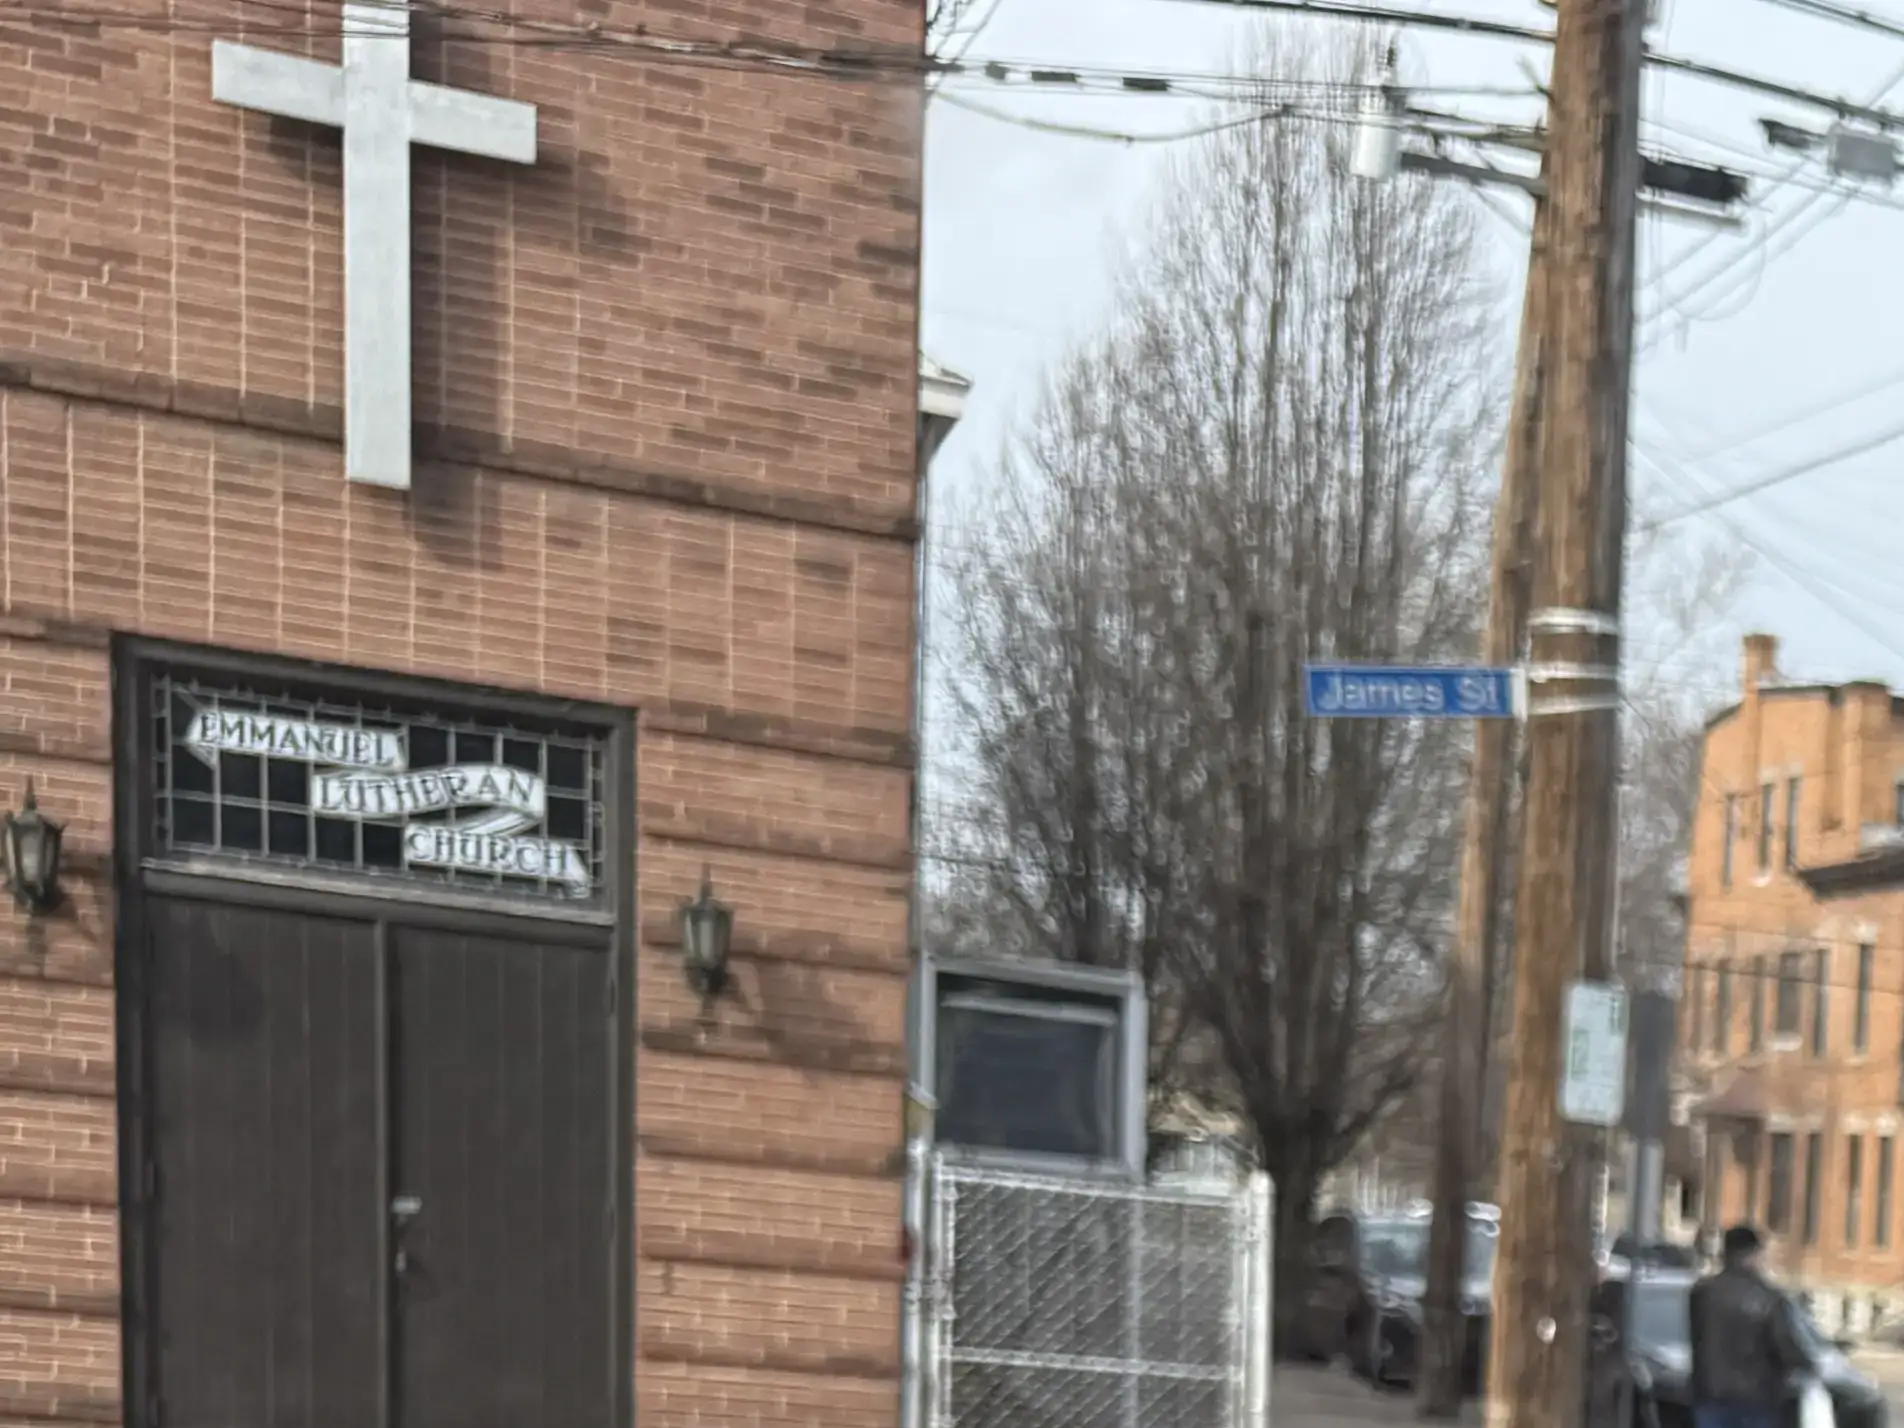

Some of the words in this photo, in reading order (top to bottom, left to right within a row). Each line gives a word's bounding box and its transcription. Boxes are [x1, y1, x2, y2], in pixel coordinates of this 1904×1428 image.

[1317, 675, 1444, 710] James
[1456, 675, 1498, 709] St
[200, 711, 397, 766] EMMANUEL
[318, 768, 536, 813] LUTHERAN
[407, 831, 570, 876] CHURCH
